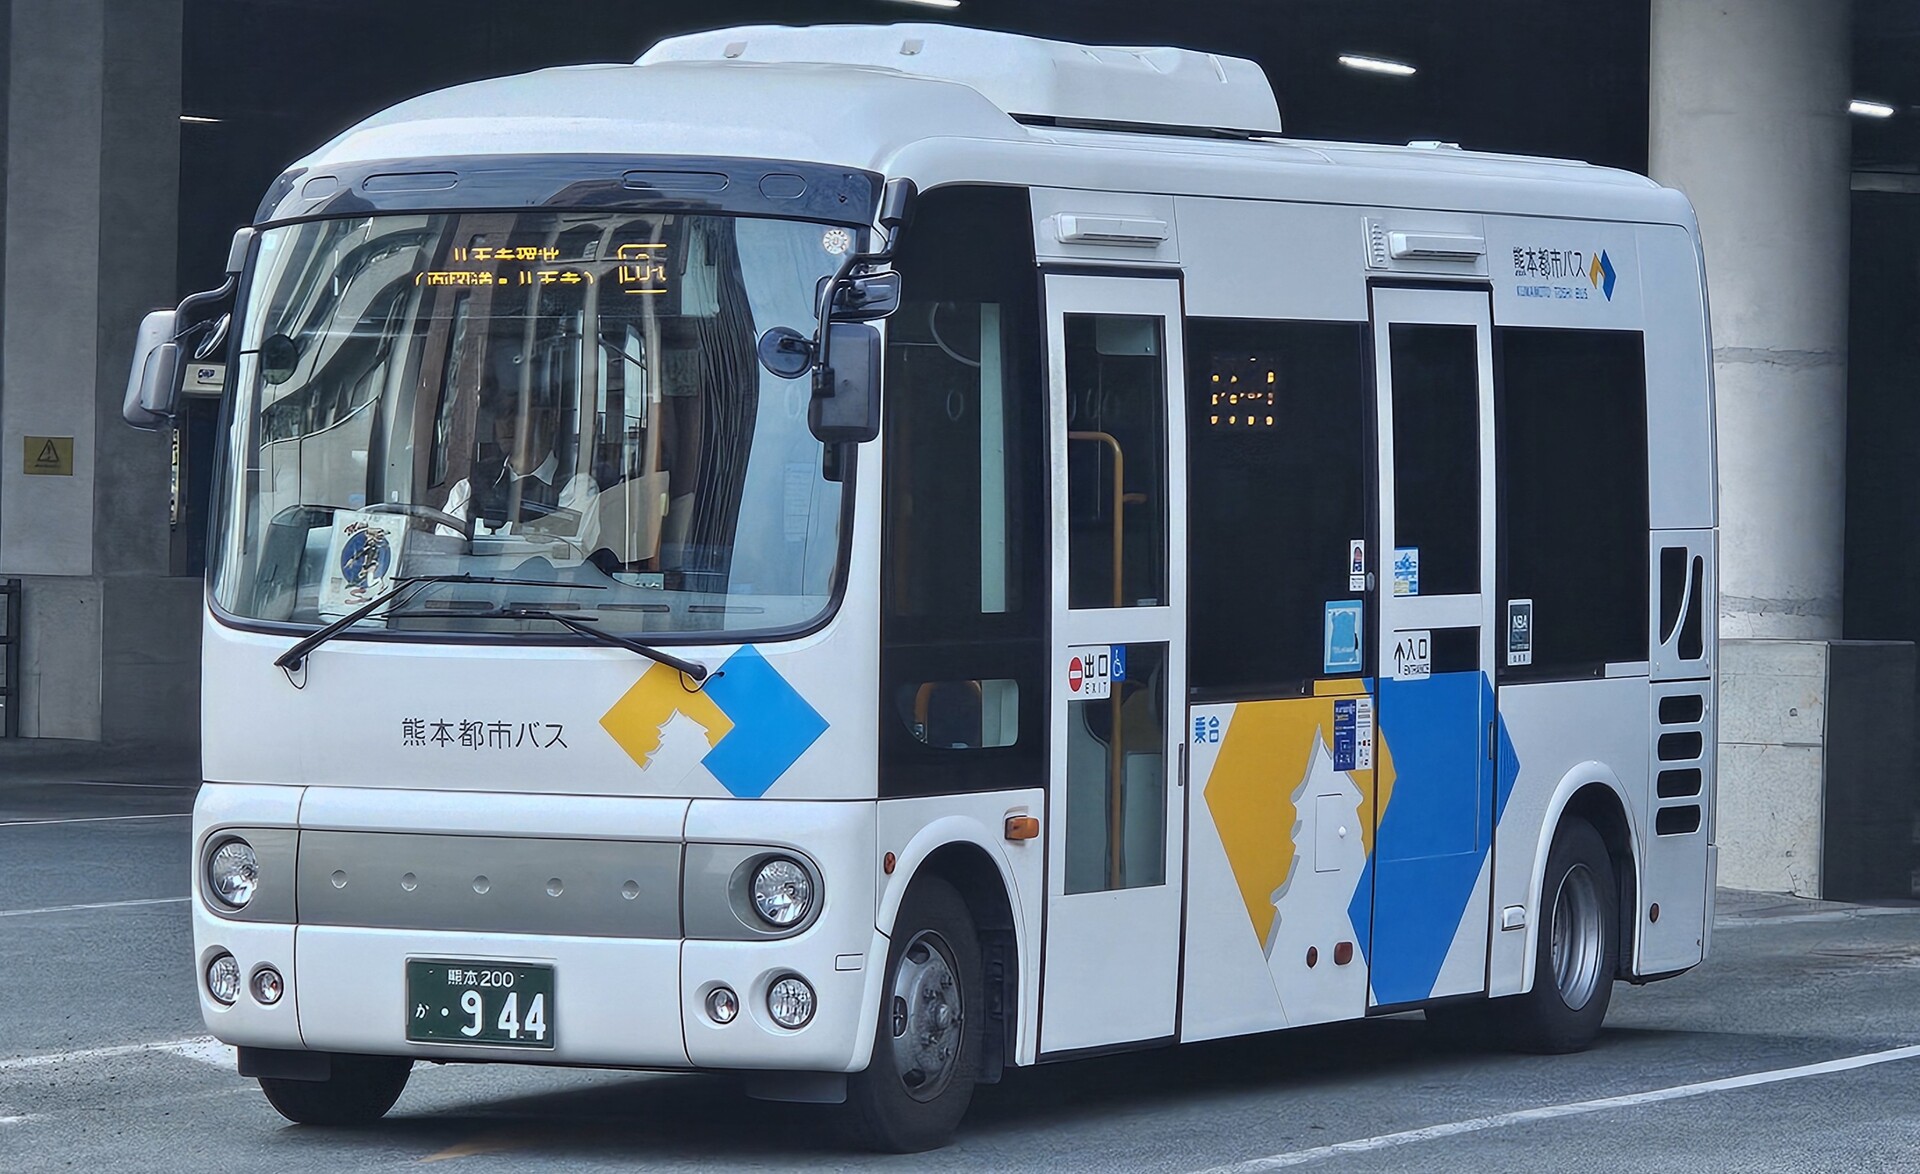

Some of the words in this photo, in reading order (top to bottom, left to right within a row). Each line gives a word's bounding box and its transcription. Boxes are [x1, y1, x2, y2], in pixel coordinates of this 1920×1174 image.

[1512, 246, 1587, 280] 熊本都市バス
[1406, 638, 1427, 661] 入口
[1084, 653, 1108, 678] 出口
[1085, 681, 1107, 695] EXIT
[401, 717, 568, 751] 熊本都市バス
[1194, 716, 1220, 744] 乗合
